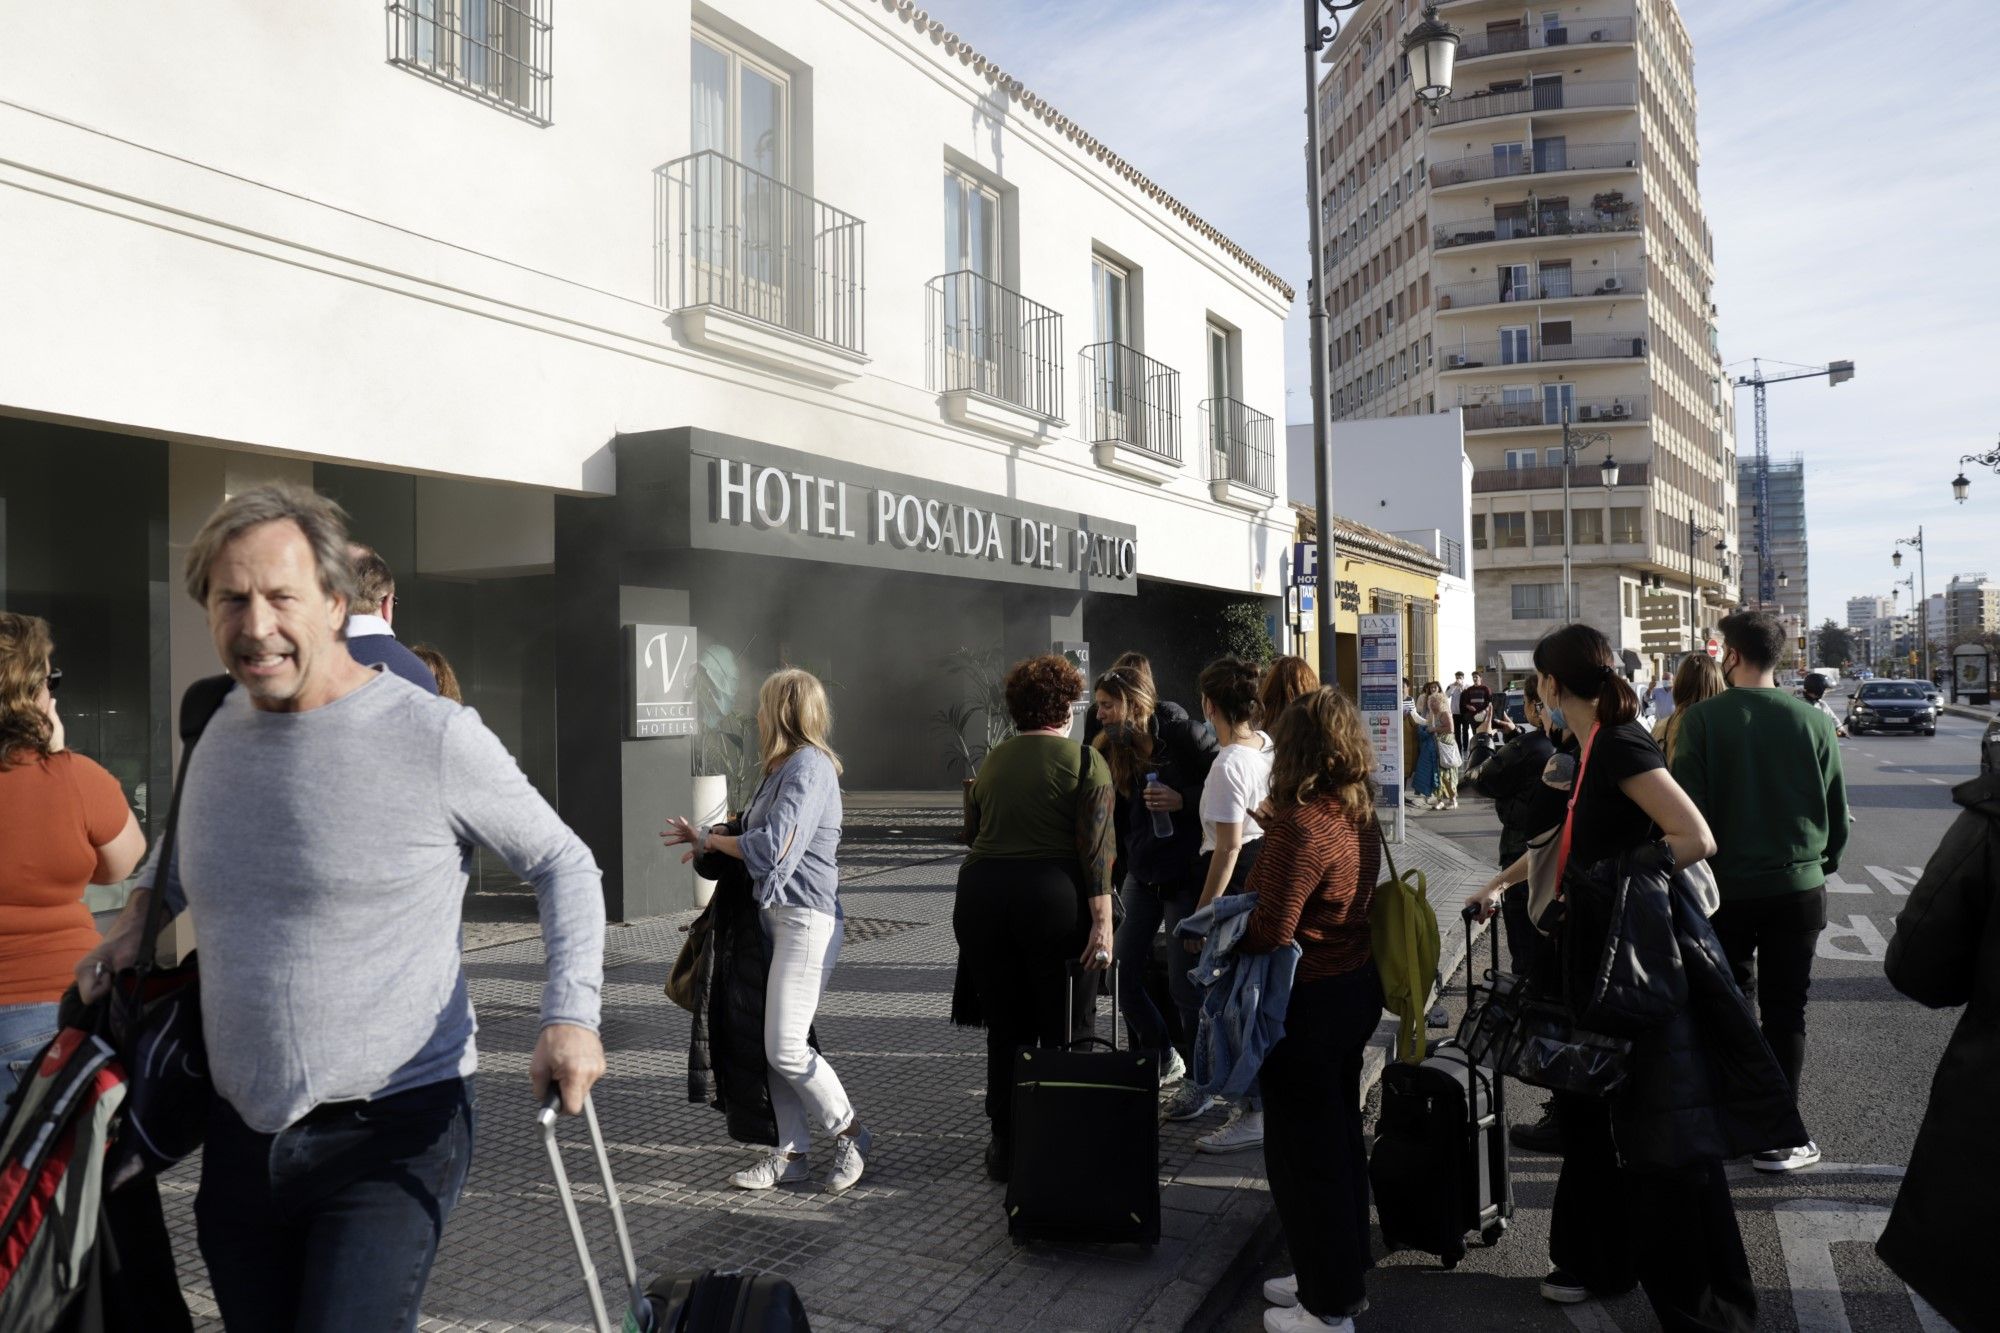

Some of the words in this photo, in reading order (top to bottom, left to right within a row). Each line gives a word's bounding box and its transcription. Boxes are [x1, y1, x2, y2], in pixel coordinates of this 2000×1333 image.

[720, 458, 856, 538] HOTEL
[877, 489, 1004, 560] POSADA
[1020, 517, 1063, 569] DEL
[1076, 529, 1136, 579] PATIO
[1303, 544, 1317, 575] P
[1297, 575, 1317, 584] HOT
[1362, 617, 1396, 629] TAXI
[644, 631, 688, 694] V
[646, 705, 691, 718] VINCCI
[641, 721, 695, 735] HOTELES
